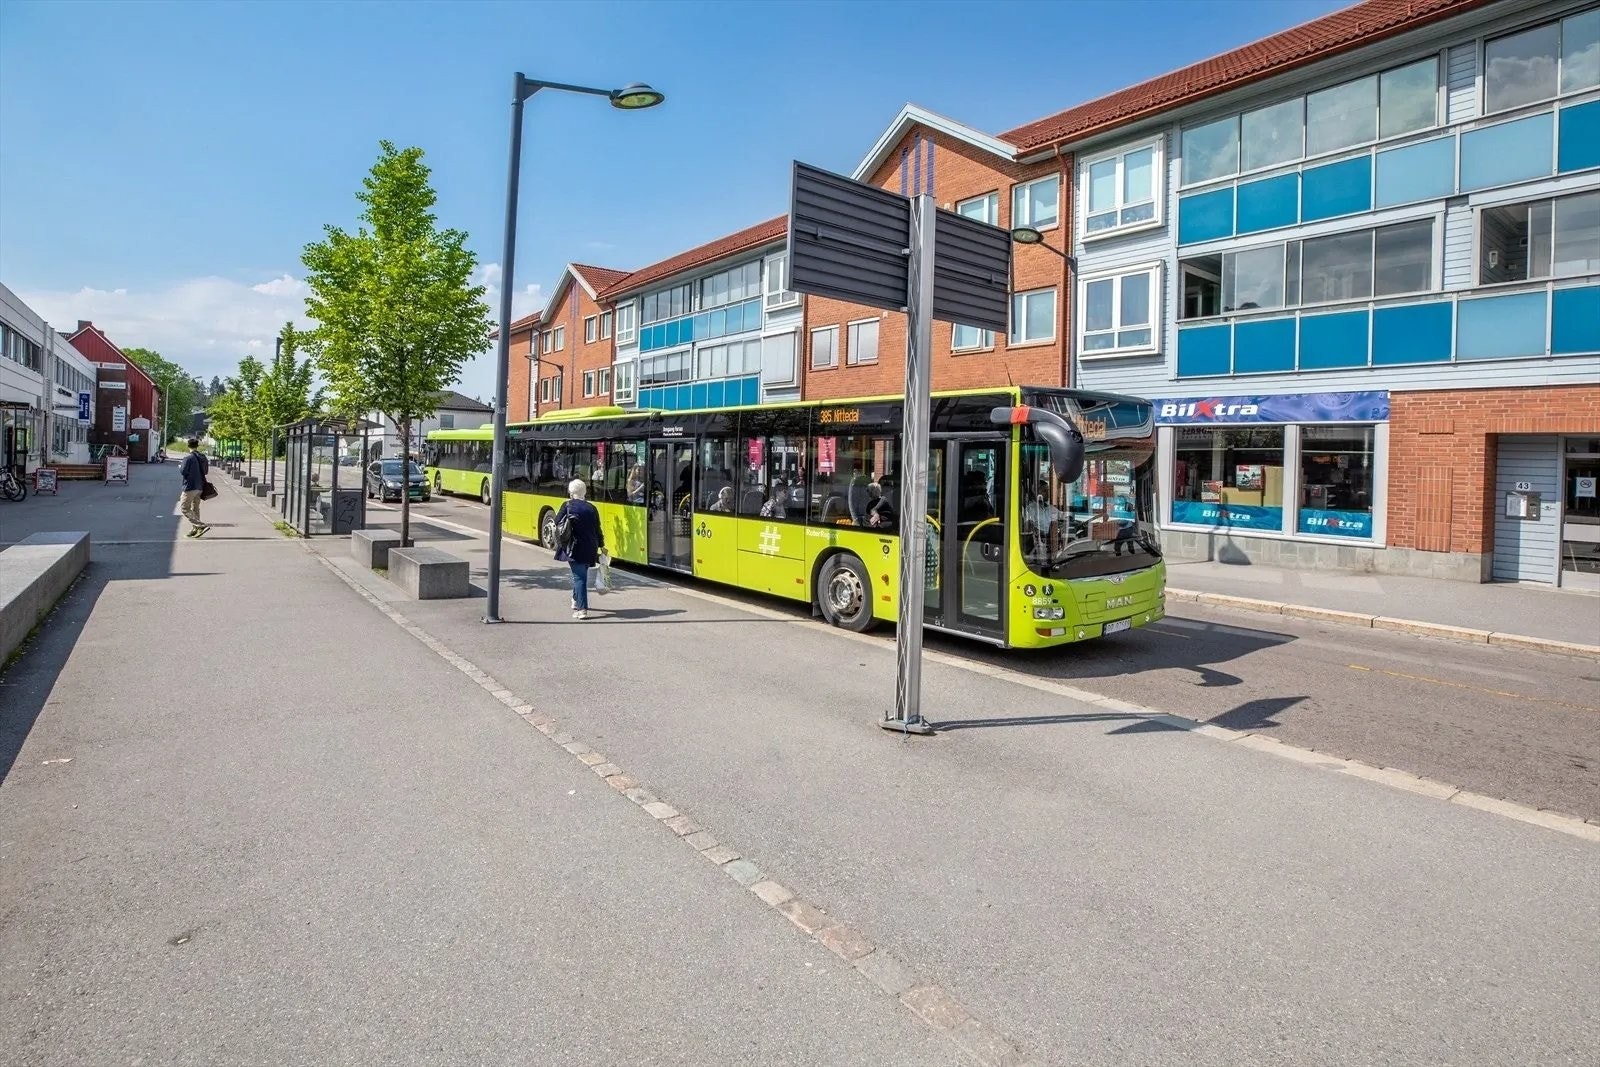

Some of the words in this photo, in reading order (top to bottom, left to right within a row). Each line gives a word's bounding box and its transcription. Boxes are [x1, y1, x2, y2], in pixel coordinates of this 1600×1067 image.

[1161, 400, 1258, 418] BilXtra
[820, 410, 832, 424] 385
[833, 408, 859, 423] Nittedal
[1202, 508, 1251, 520] BilXtra
[1307, 517, 1363, 529] BilXtra
[1032, 597, 1051, 606] 8859
[1105, 595, 1131, 609] MAN
